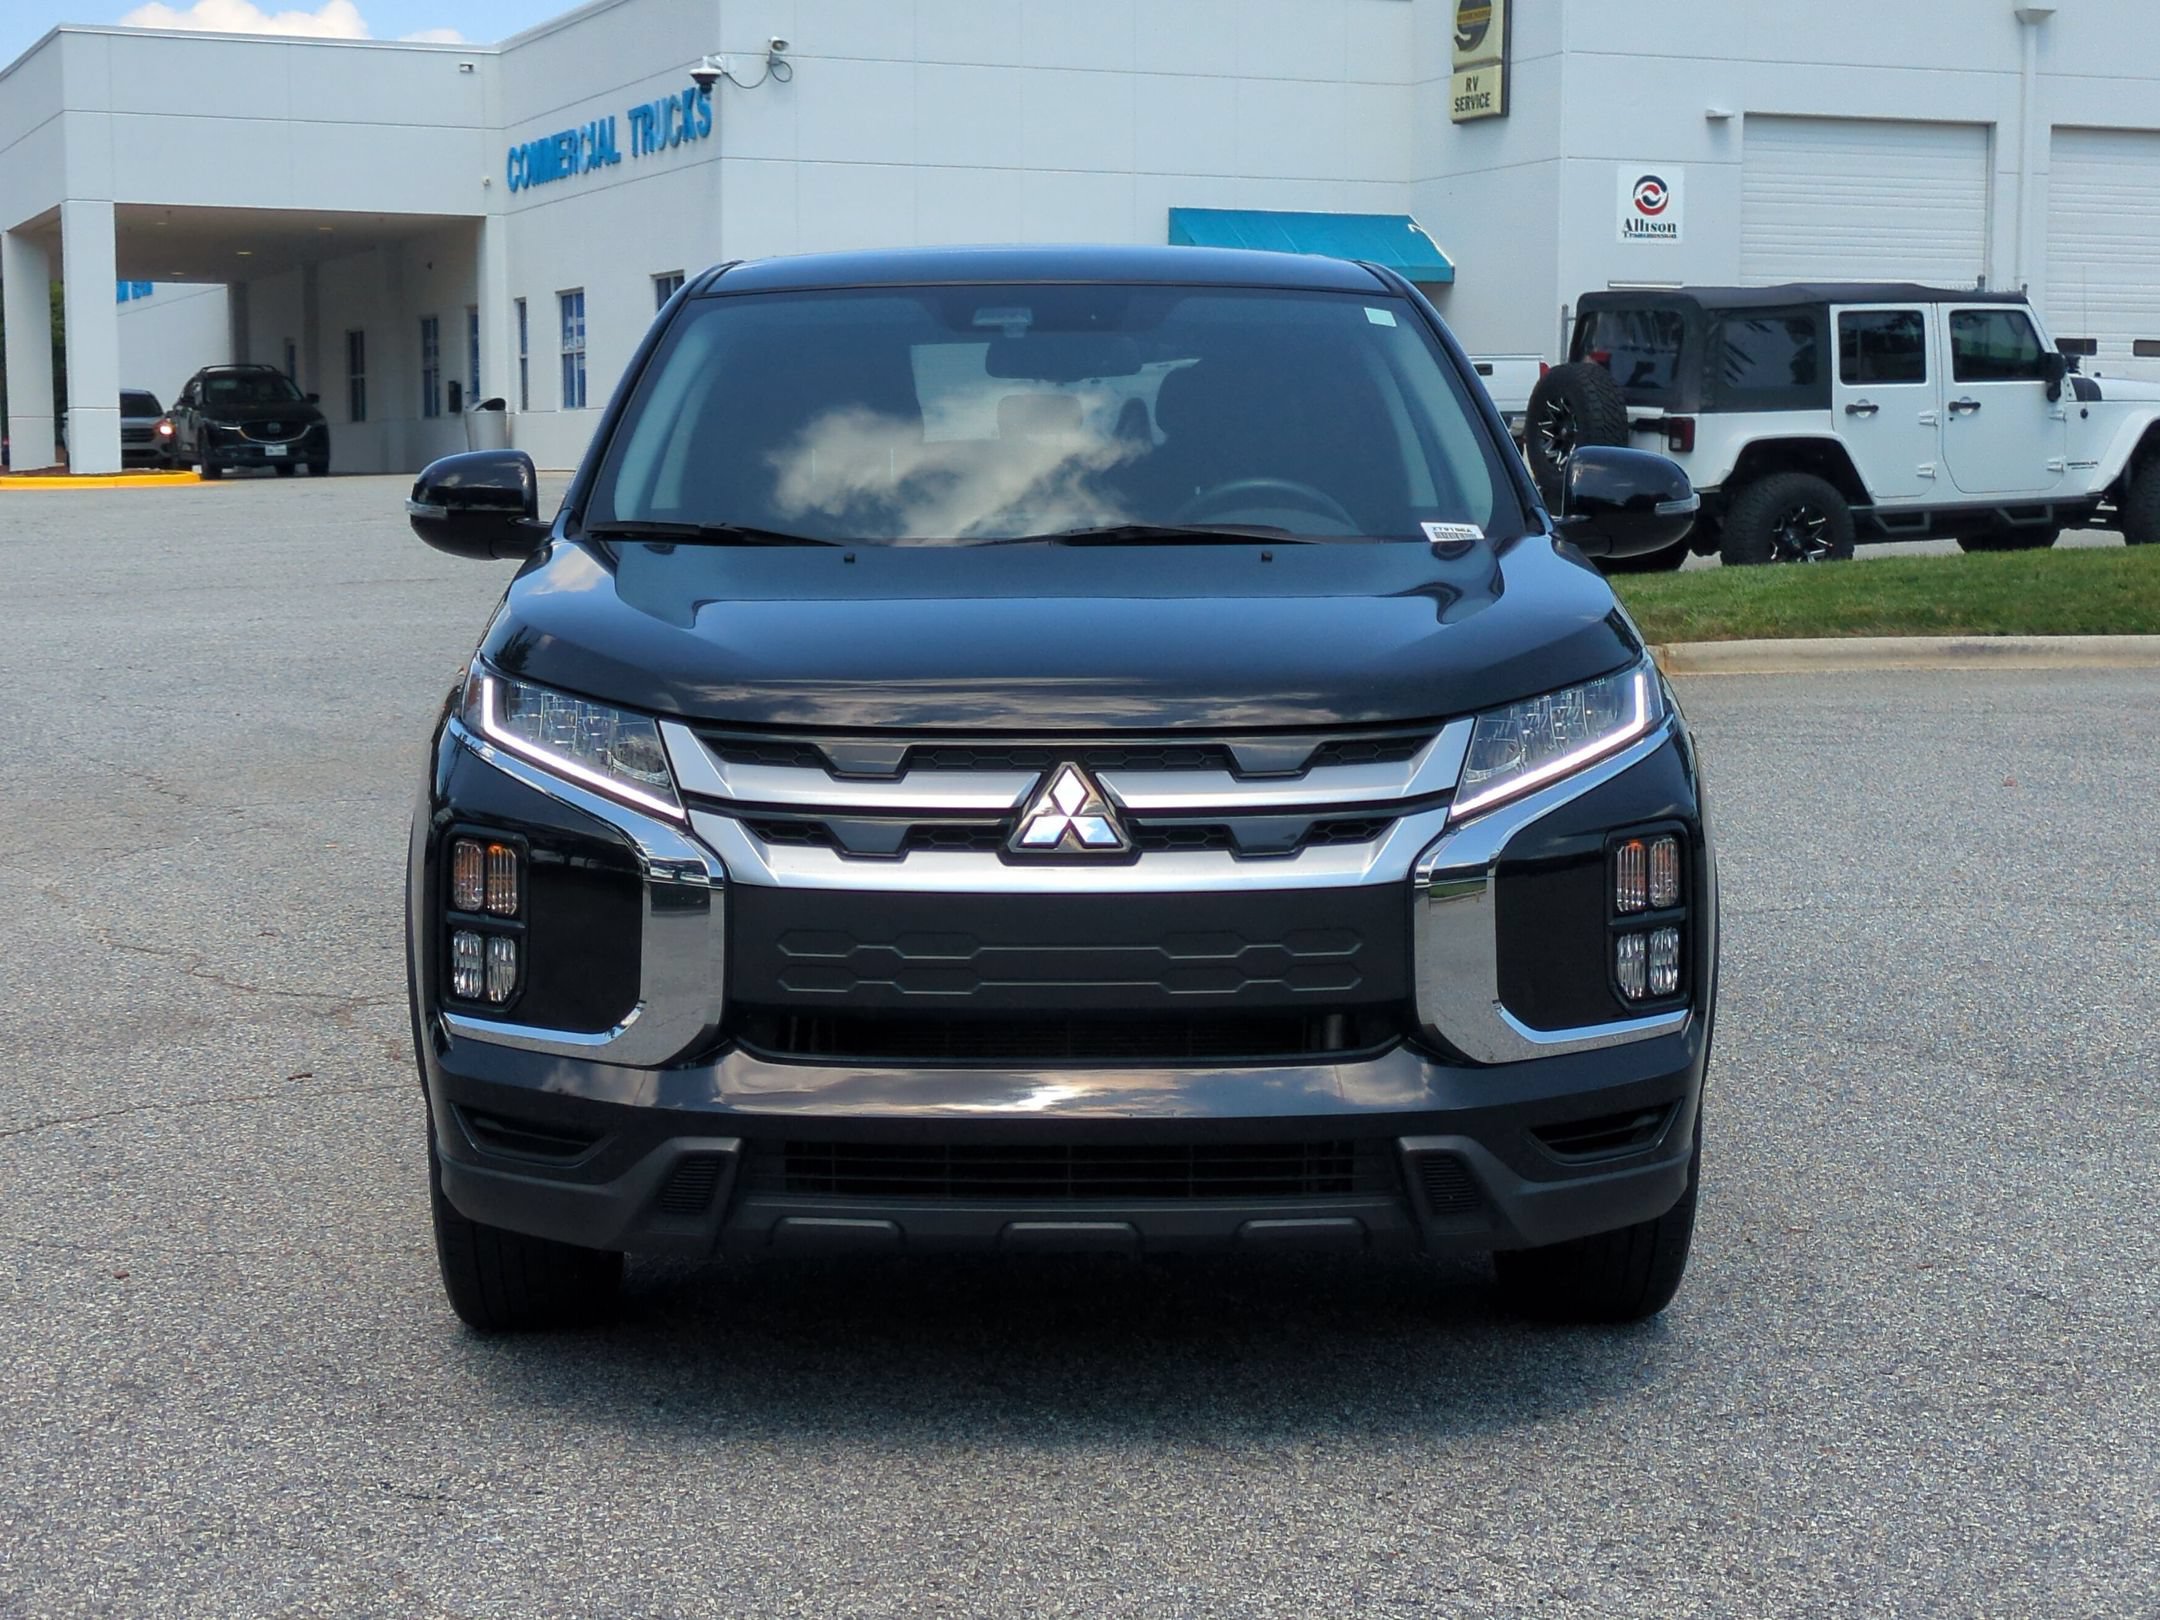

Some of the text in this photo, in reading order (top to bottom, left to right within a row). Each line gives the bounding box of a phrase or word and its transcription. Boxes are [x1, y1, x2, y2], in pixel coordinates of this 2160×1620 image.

[1465, 75, 1479, 92] RV
[1454, 92, 1491, 112] SERVICE
[507, 86, 713, 193] COMMERCIAL TRUCKS
[1622, 217, 1677, 233] Allison
